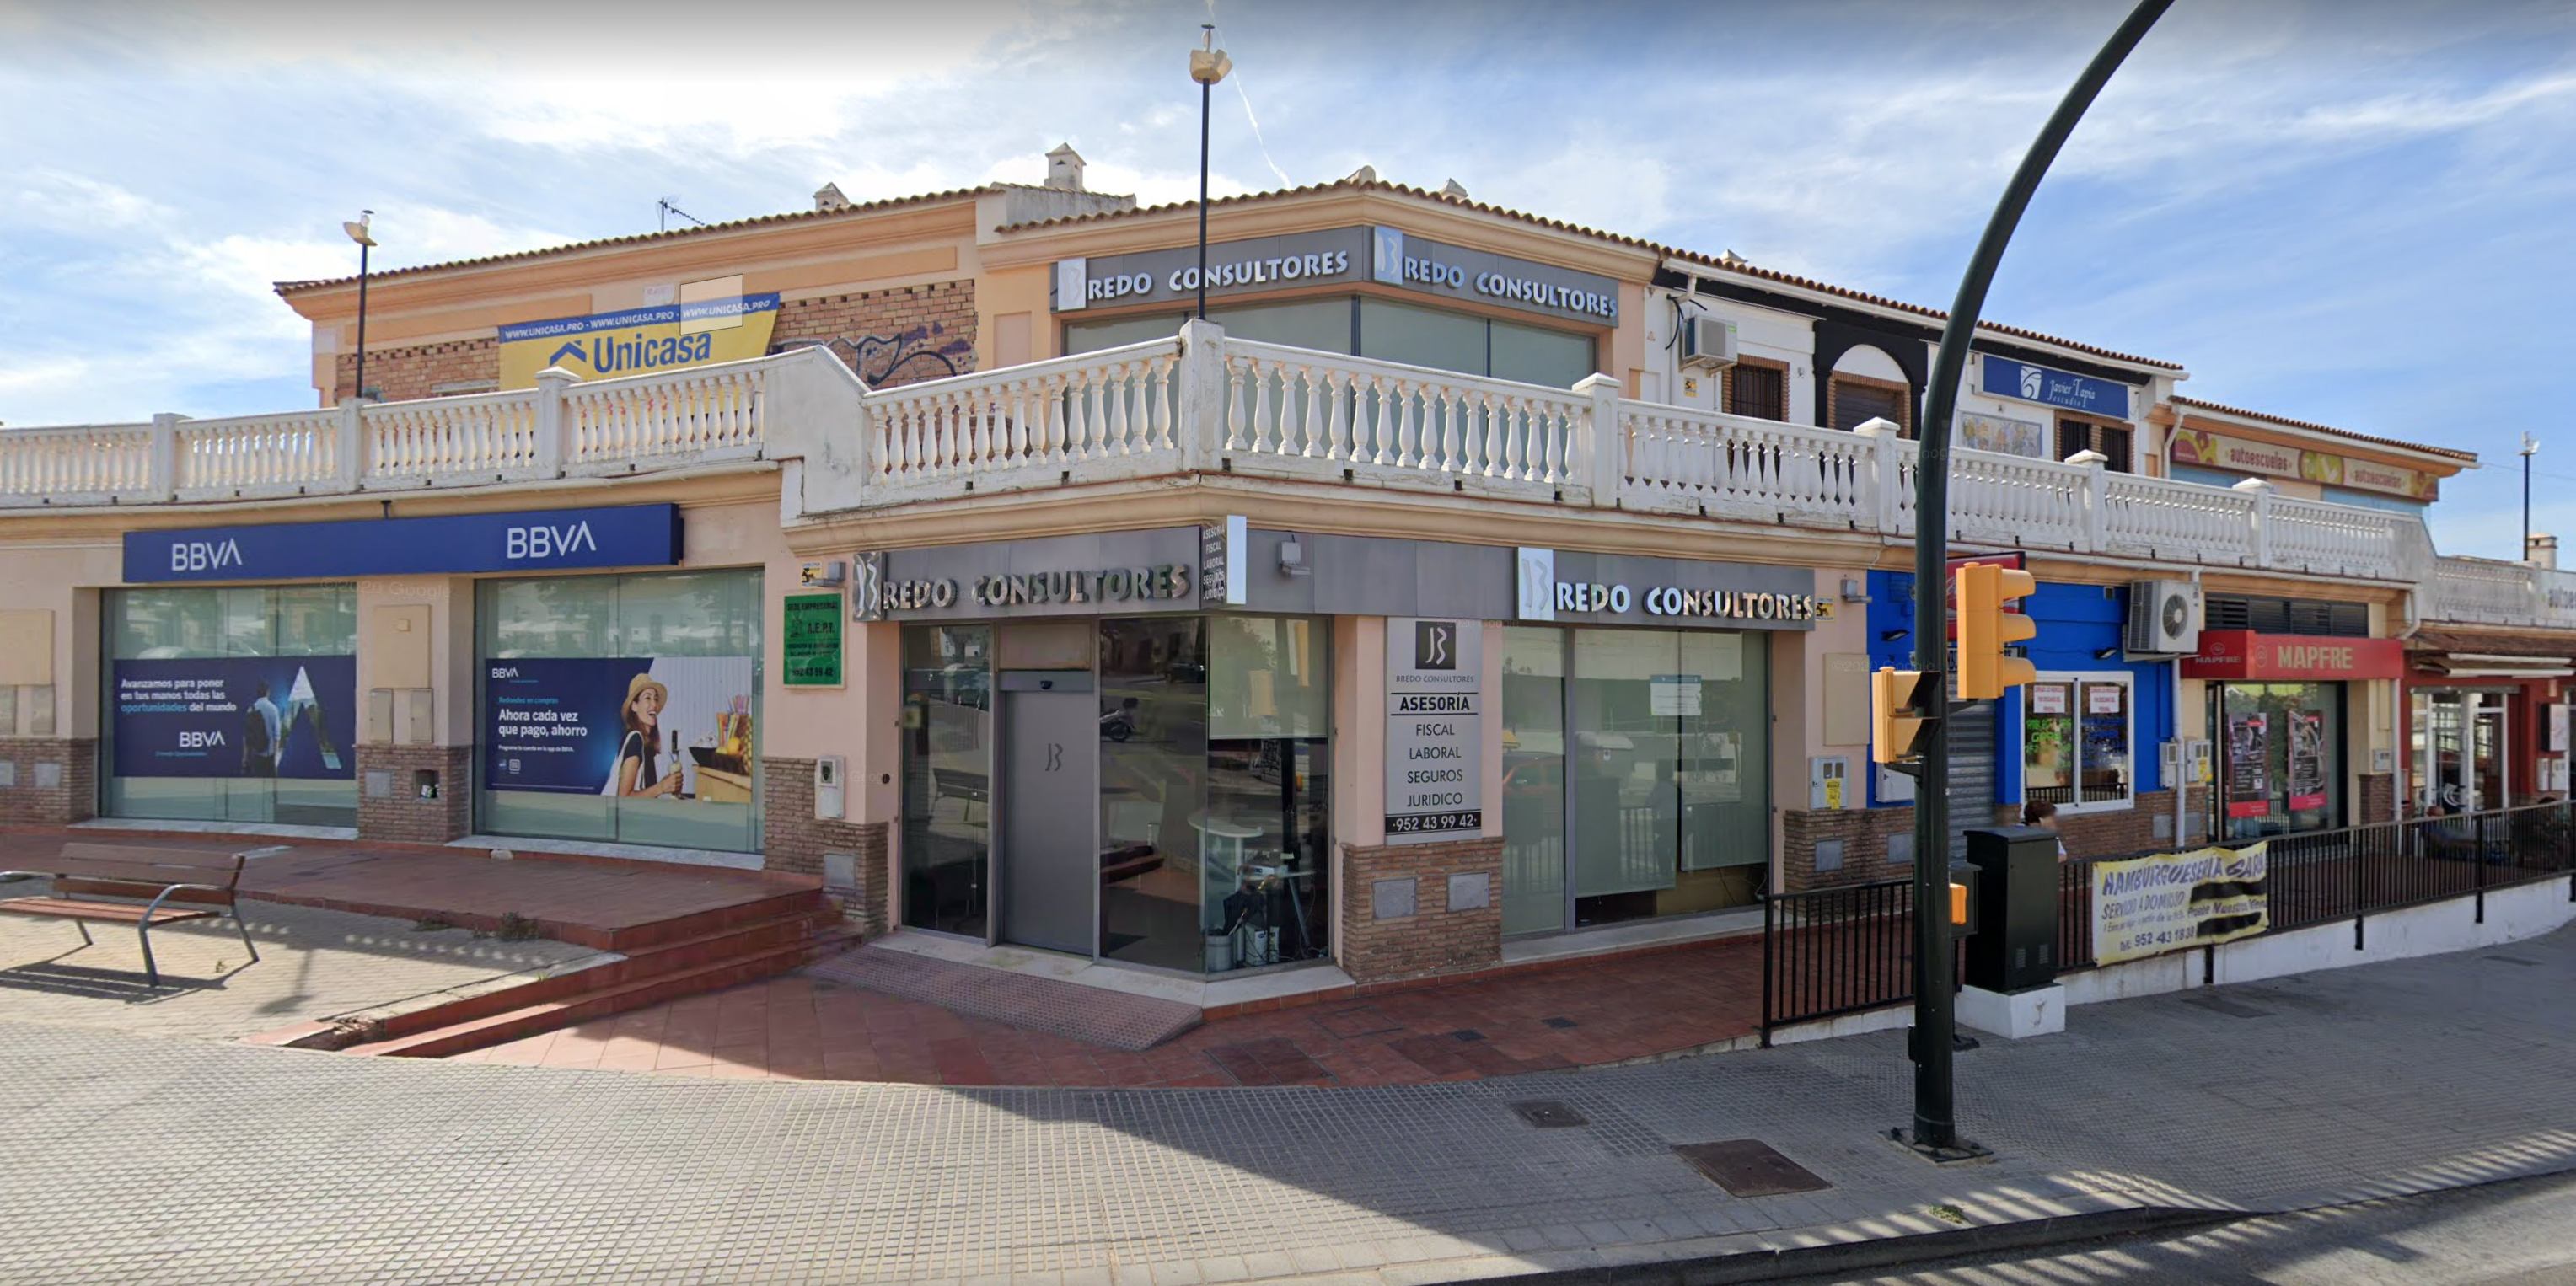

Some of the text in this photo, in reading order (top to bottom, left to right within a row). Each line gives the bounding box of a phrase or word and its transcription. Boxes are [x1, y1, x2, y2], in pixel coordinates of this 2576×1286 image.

[1169, 250, 1349, 292] CONSULTORES
[1475, 272, 1618, 317] CONSULTORES
[506, 299, 770, 340] WWW.UNICASA.PRO WWW.UNICASA.PRO WWW.UNICASA.PRO
[594, 333, 711, 373] Unicasa
[2074, 378, 2096, 407] Tapia
[2230, 447, 2289, 471] autoescuelas
[507, 521, 596, 559] BBVA
[171, 539, 242, 571] BBVA
[1205, 542, 1221, 555] FISCAL
[1203, 555, 1224, 570] LABORAL
[972, 563, 1191, 606] CONSULTORES
[1203, 571, 1225, 585] SEGUROS
[1644, 587, 1813, 620] CONSULTORES
[2278, 646, 2354, 669] MAPFRE
[491, 667, 518, 678] BBVA
[1423, 675, 1474, 683] CONSULTORES
[121, 678, 224, 689] Avanzamos para poner
[134, 691, 148, 700] tus
[152, 692, 181, 700] manos
[184, 691, 210, 700] todas
[212, 690, 225, 699] las
[121, 702, 237, 714] oportunidades del mundo
[498, 709, 578, 721] Ahora cada vez
[498, 724, 588, 738] que pago, ahorro
[1416, 724, 1455, 737] FISCAL
[180, 731, 225, 747] BBVA
[1409, 746, 1462, 759] LABORAL
[1407, 769, 1463, 784] SEGUROS
[1407, 792, 1463, 807] JURIDICO
[1423, 817, 1437, 830] 43
[1441, 815, 1456, 829] 99
[2135, 932, 2153, 947] 952
[2156, 930, 2171, 944] 43
